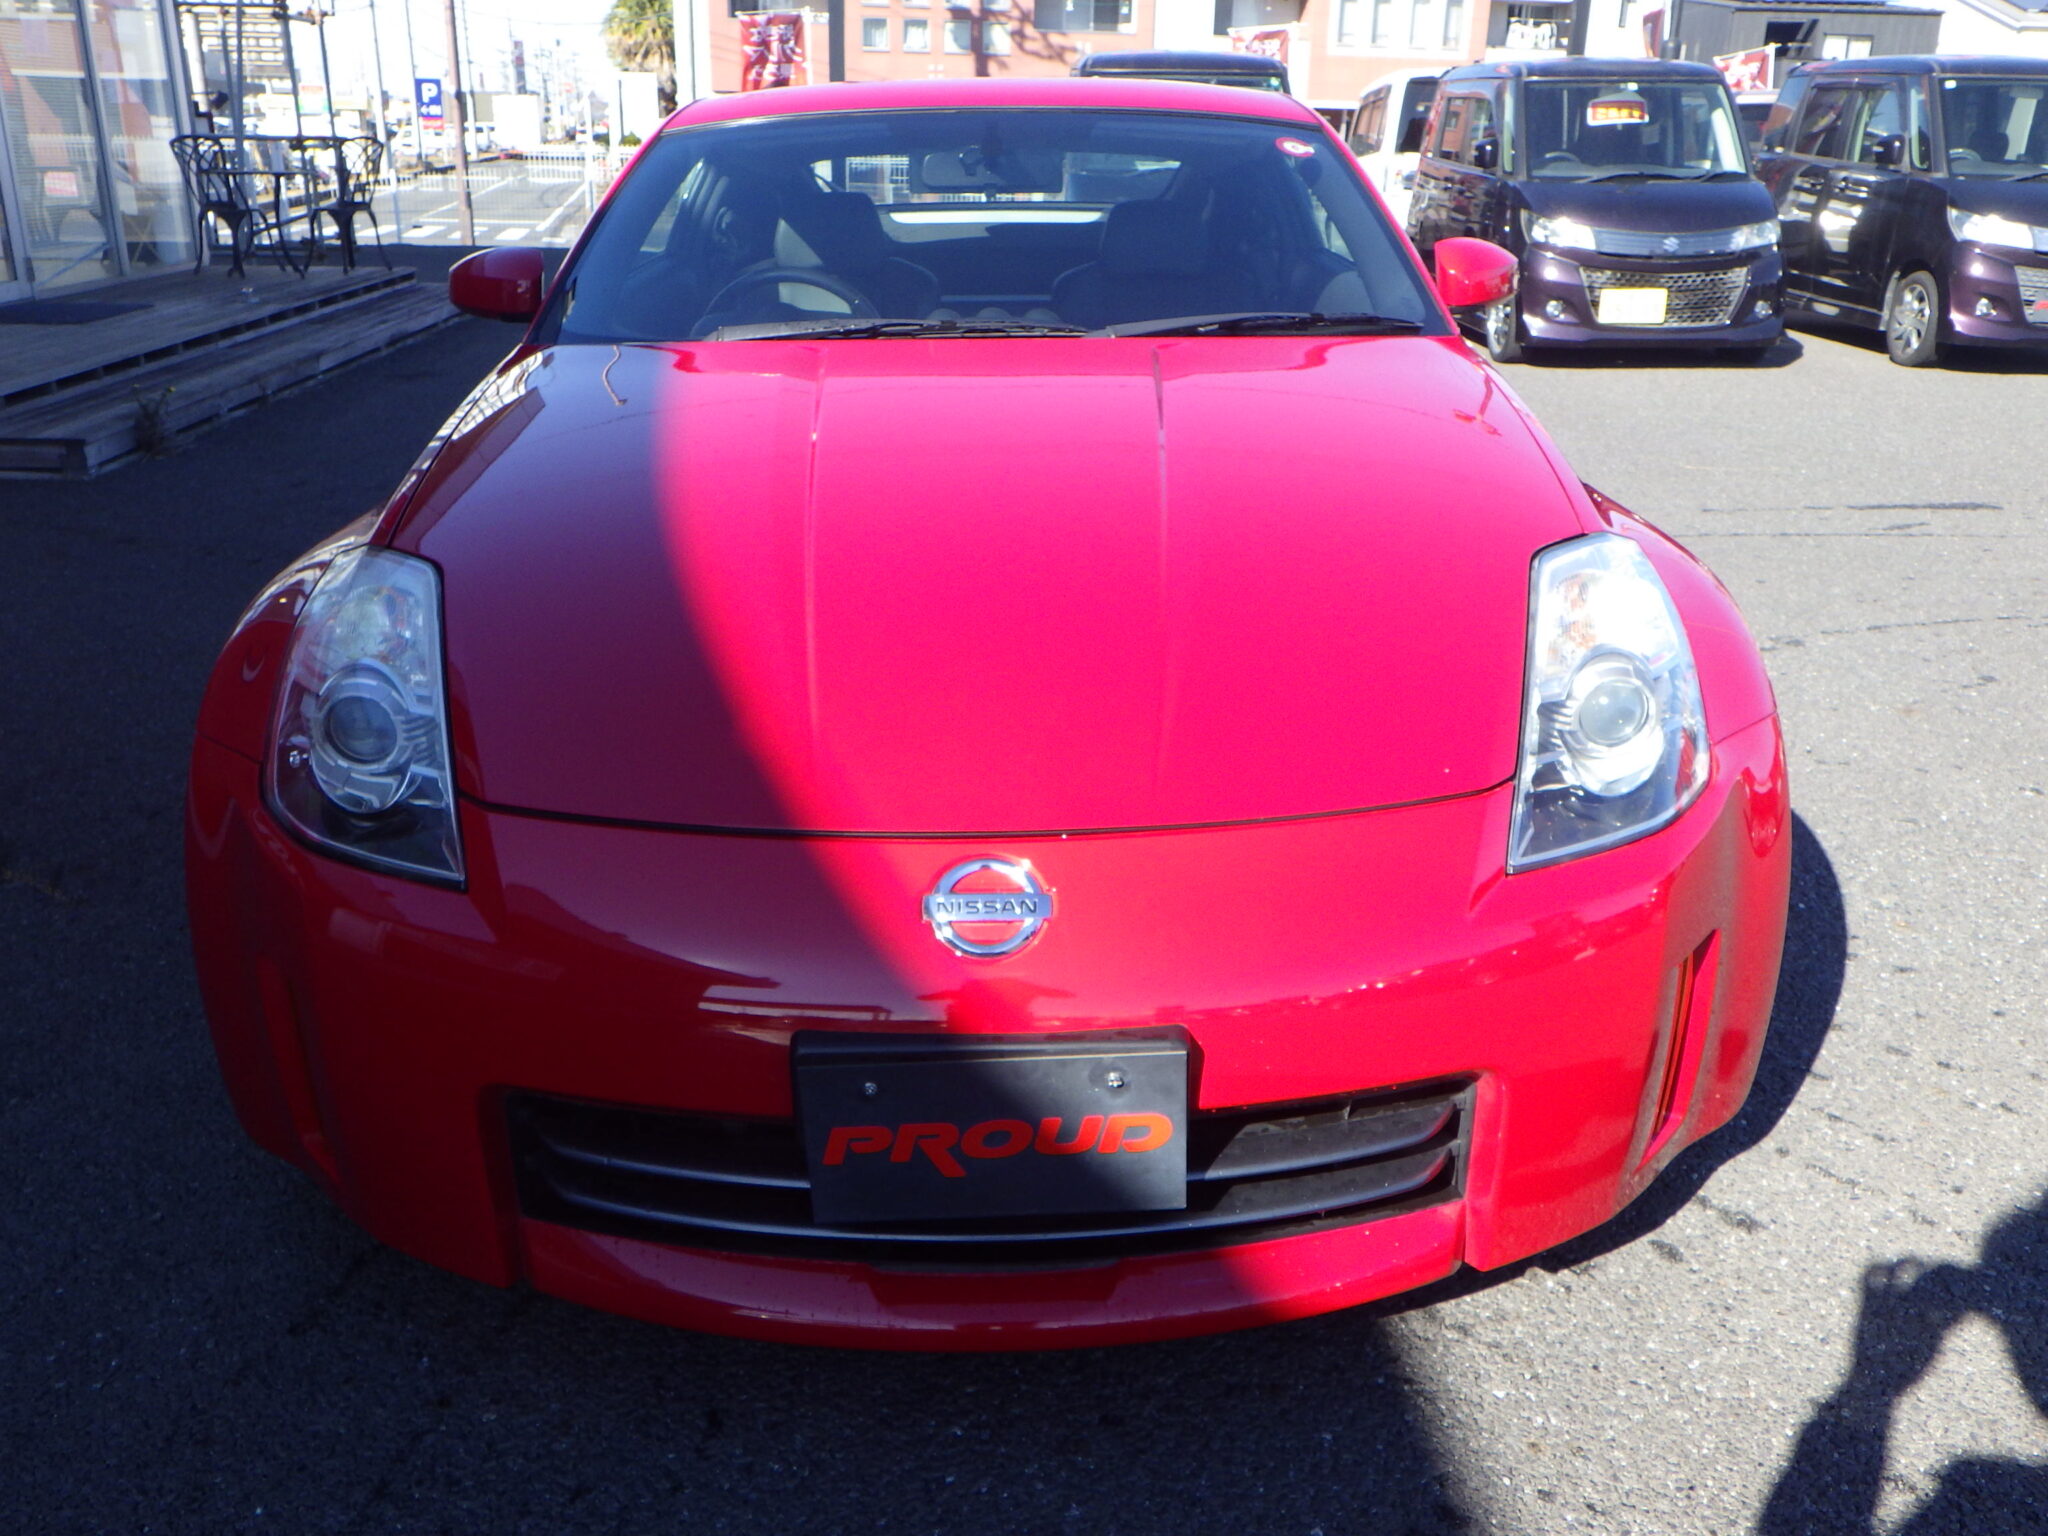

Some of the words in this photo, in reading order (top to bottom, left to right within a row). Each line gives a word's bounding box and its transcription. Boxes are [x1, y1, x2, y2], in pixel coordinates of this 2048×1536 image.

[421, 82, 438, 103] P
[936, 899, 1037, 915] NISSAN
[822, 1112, 1174, 1178] PROUD
